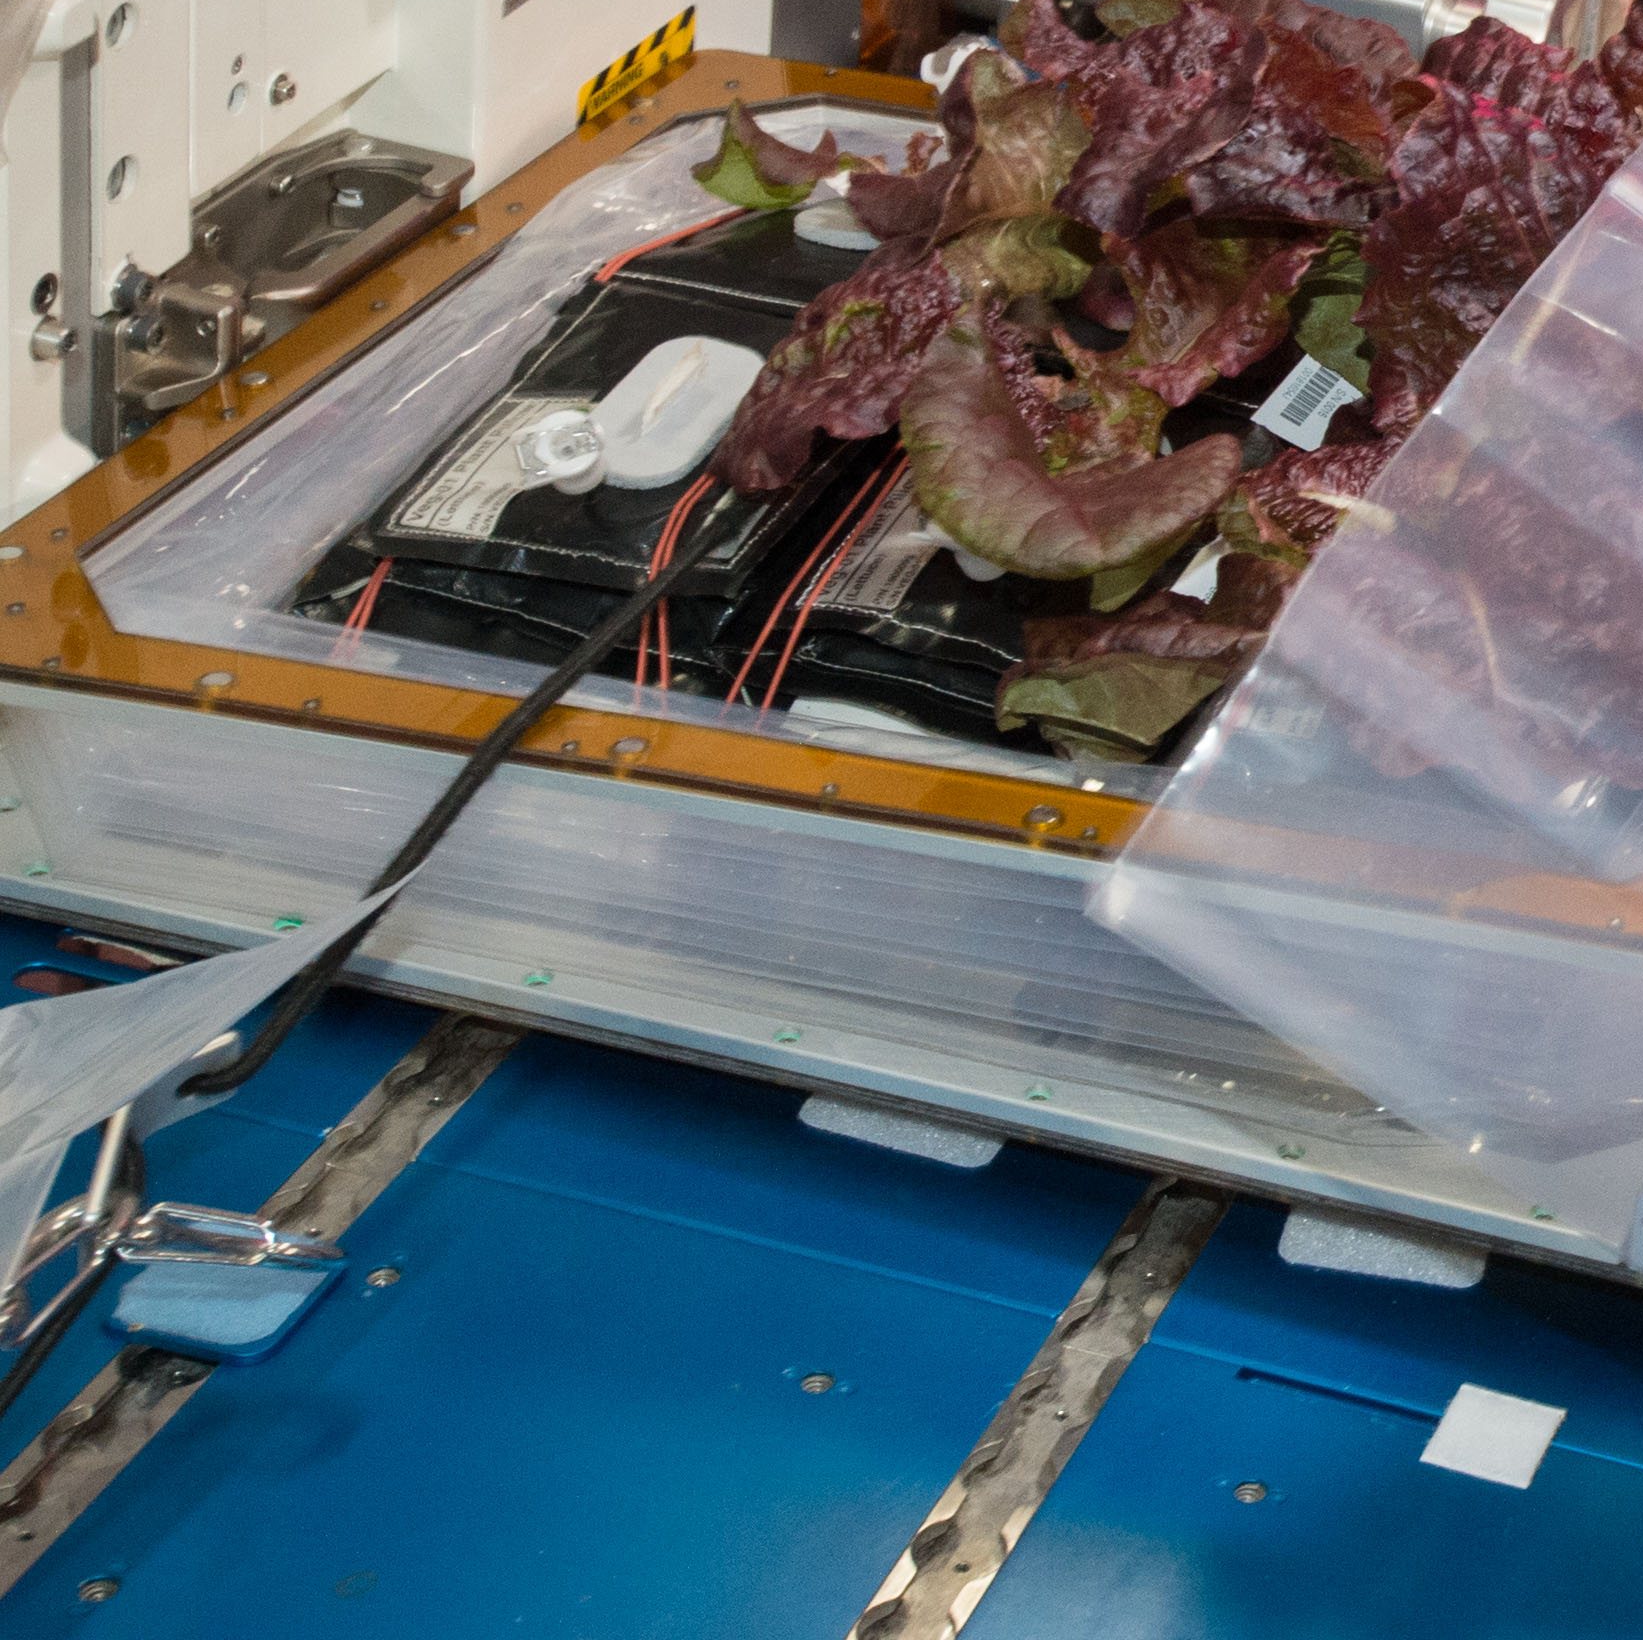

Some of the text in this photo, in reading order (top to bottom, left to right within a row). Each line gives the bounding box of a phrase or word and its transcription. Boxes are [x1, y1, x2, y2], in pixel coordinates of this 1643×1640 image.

[1331, 388, 1346, 404] S/N
[406, 474, 455, 521] Veg-01
[456, 437, 494, 475] Plant
[855, 512, 886, 549] Plant
[845, 553, 887, 600] (Lettuce)
